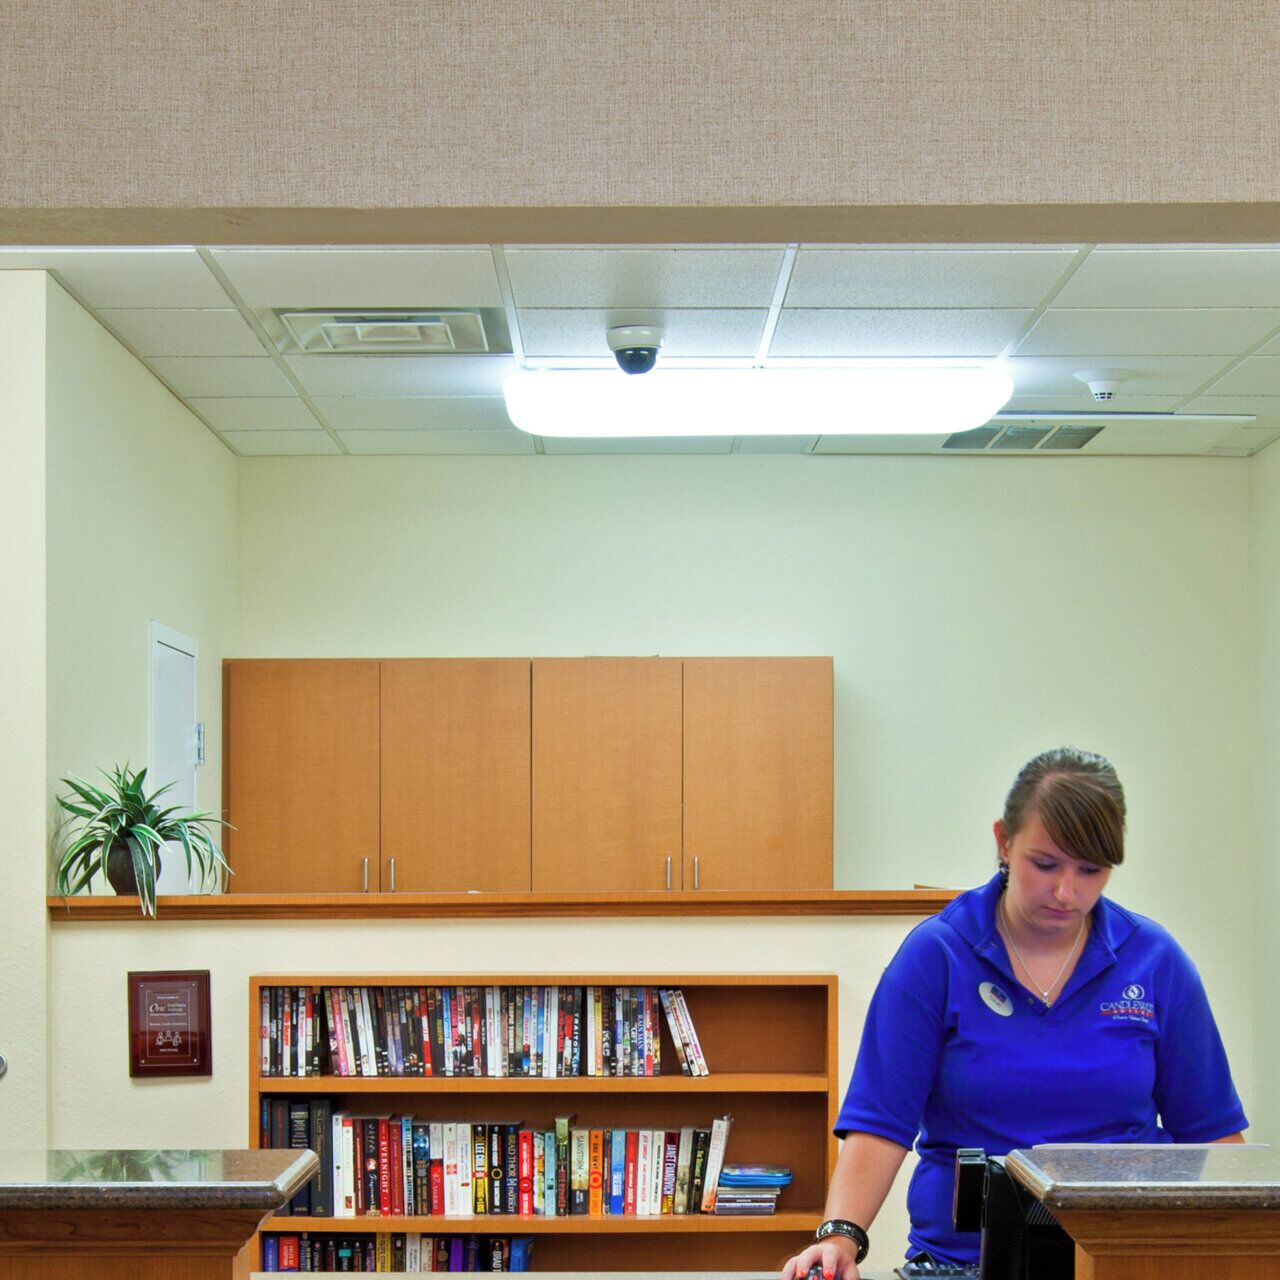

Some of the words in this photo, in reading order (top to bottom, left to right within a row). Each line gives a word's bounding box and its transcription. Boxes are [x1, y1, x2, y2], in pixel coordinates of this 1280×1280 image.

[637, 1032, 645, 1050] MAN
[508, 1134, 516, 1155] BRAD
[576, 1135, 585, 1170] SANDSTORM
[665, 1144, 677, 1162] JANET
[380, 1141, 390, 1194] EVERNIGHT
[508, 1156, 517, 1177] THOR
[663, 1162, 676, 1195] EVANOVICH
